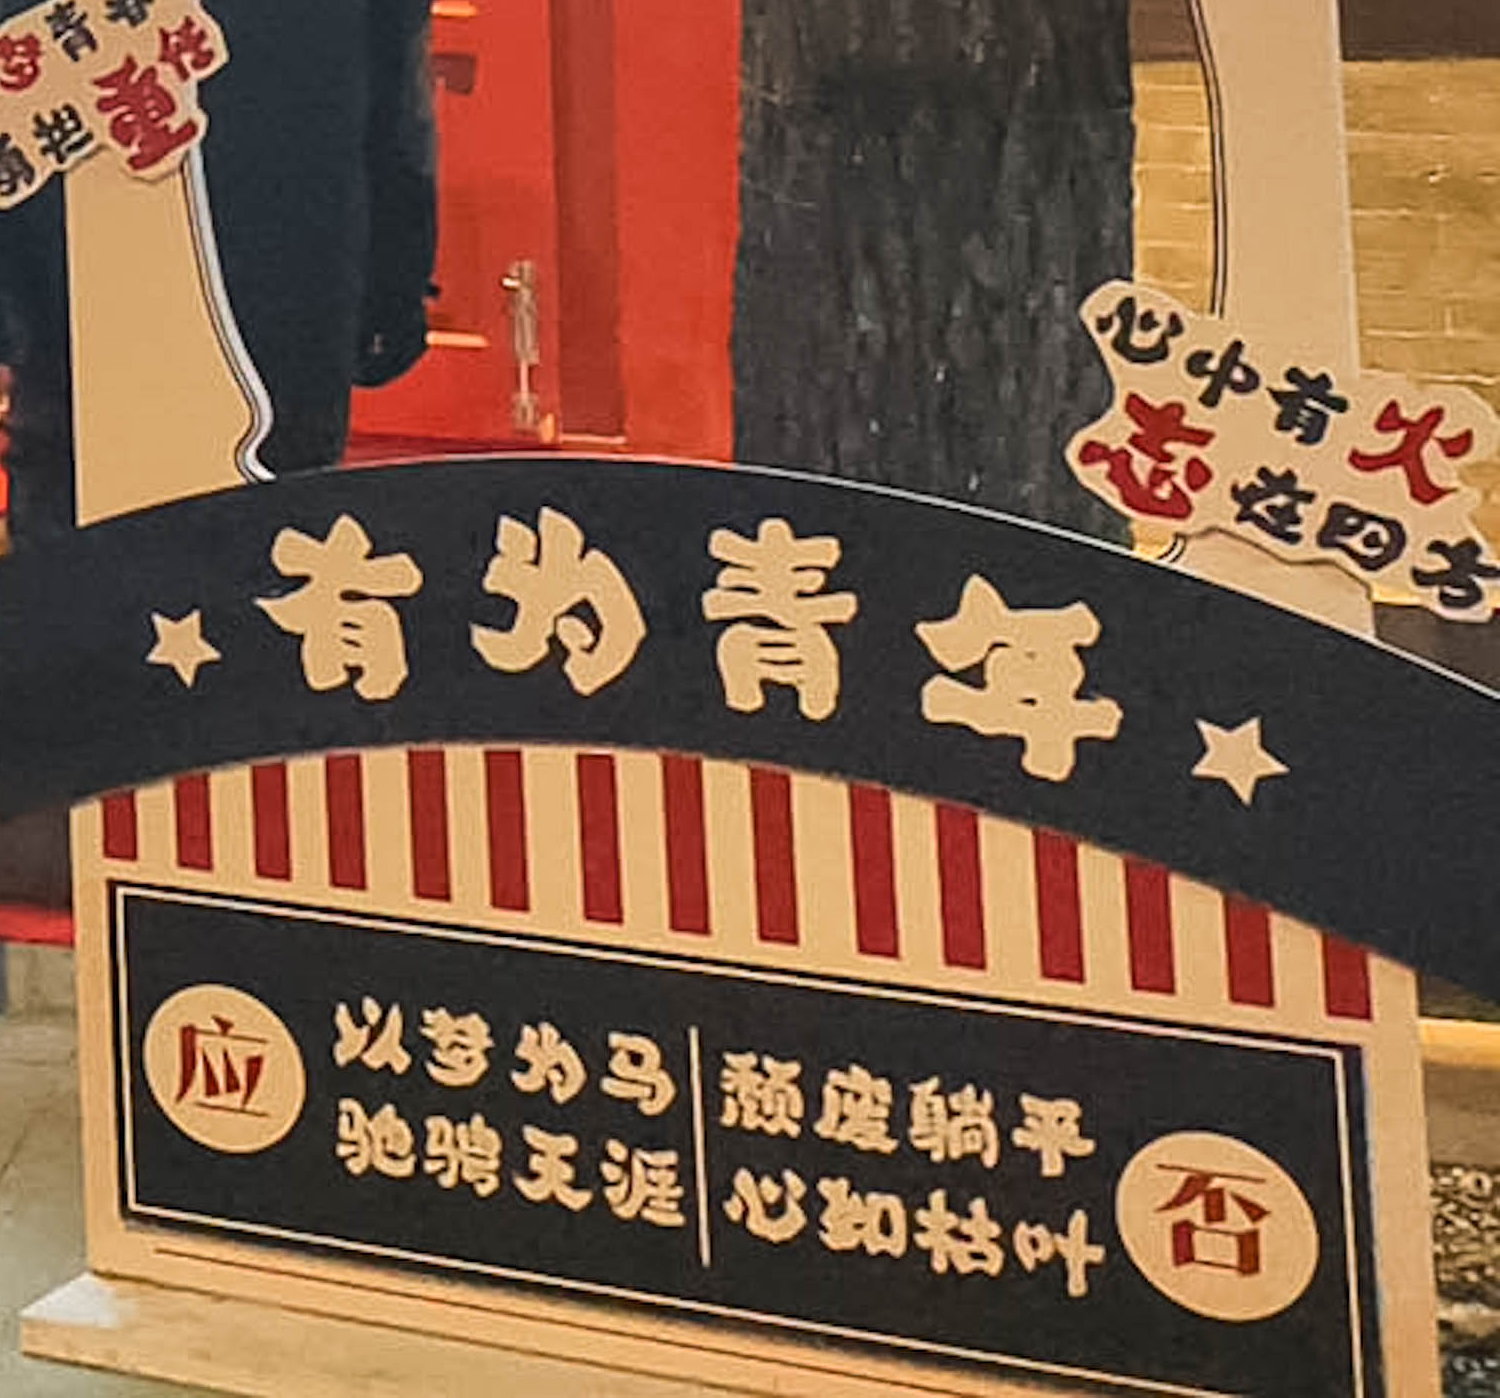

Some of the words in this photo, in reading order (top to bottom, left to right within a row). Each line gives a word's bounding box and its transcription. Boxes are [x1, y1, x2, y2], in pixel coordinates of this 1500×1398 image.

[1094, 296, 1475, 506] 心中有火
[1078, 391, 1500, 609] 志在四方
[254, 506, 1124, 782] 有为青年
[176, 1016, 271, 1119] 应
[332, 995, 678, 1117] 以梦为马
[720, 1048, 1098, 1179] 颓废躺平
[334, 1097, 687, 1229] 驰骋天涯
[1154, 1163, 1272, 1278] 否
[722, 1166, 1107, 1299] 心如枯叶
